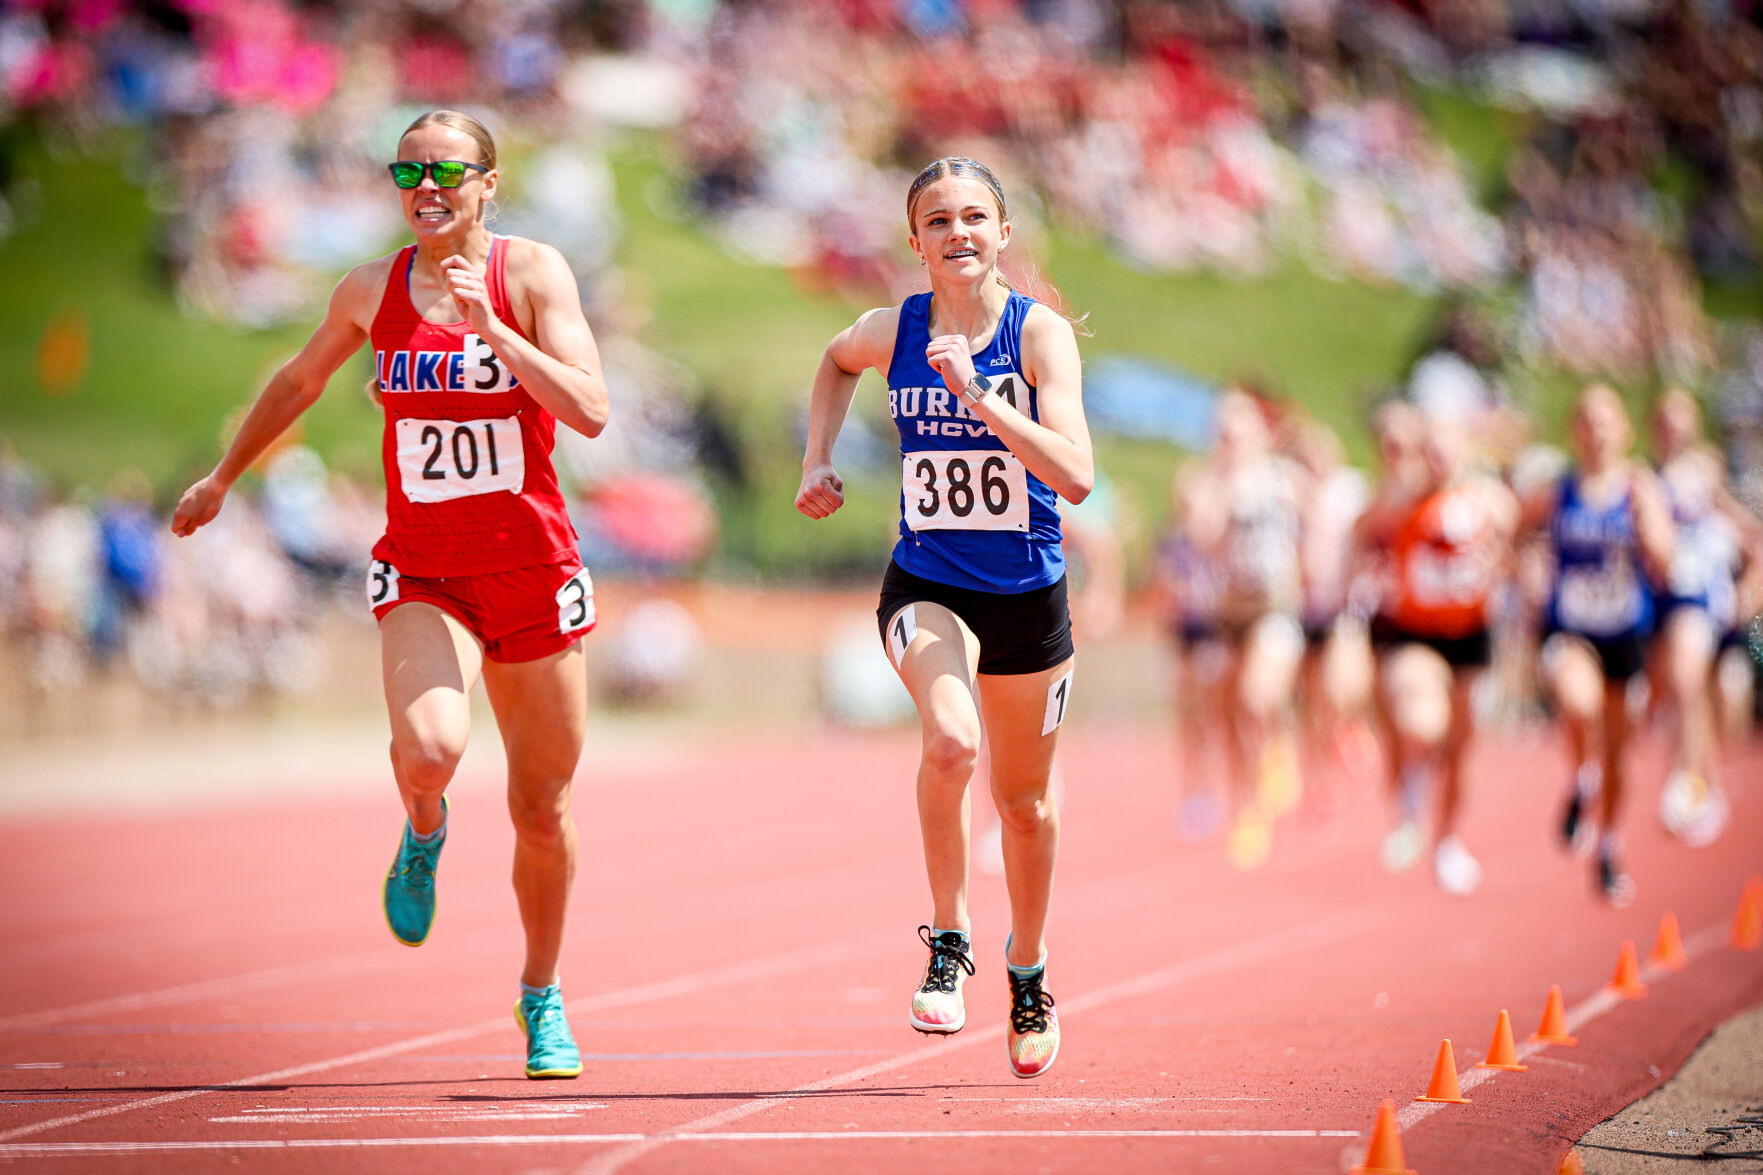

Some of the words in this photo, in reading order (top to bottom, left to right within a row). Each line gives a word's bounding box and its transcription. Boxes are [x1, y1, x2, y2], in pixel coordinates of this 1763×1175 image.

[475, 338, 500, 390] 3
[421, 423, 499, 480] 201
[916, 420, 998, 437] HCV
[915, 456, 1010, 518] 386
[372, 560, 392, 603] 3
[565, 577, 587, 627] 3
[894, 615, 908, 650] 1
[1055, 677, 1067, 724] 1
